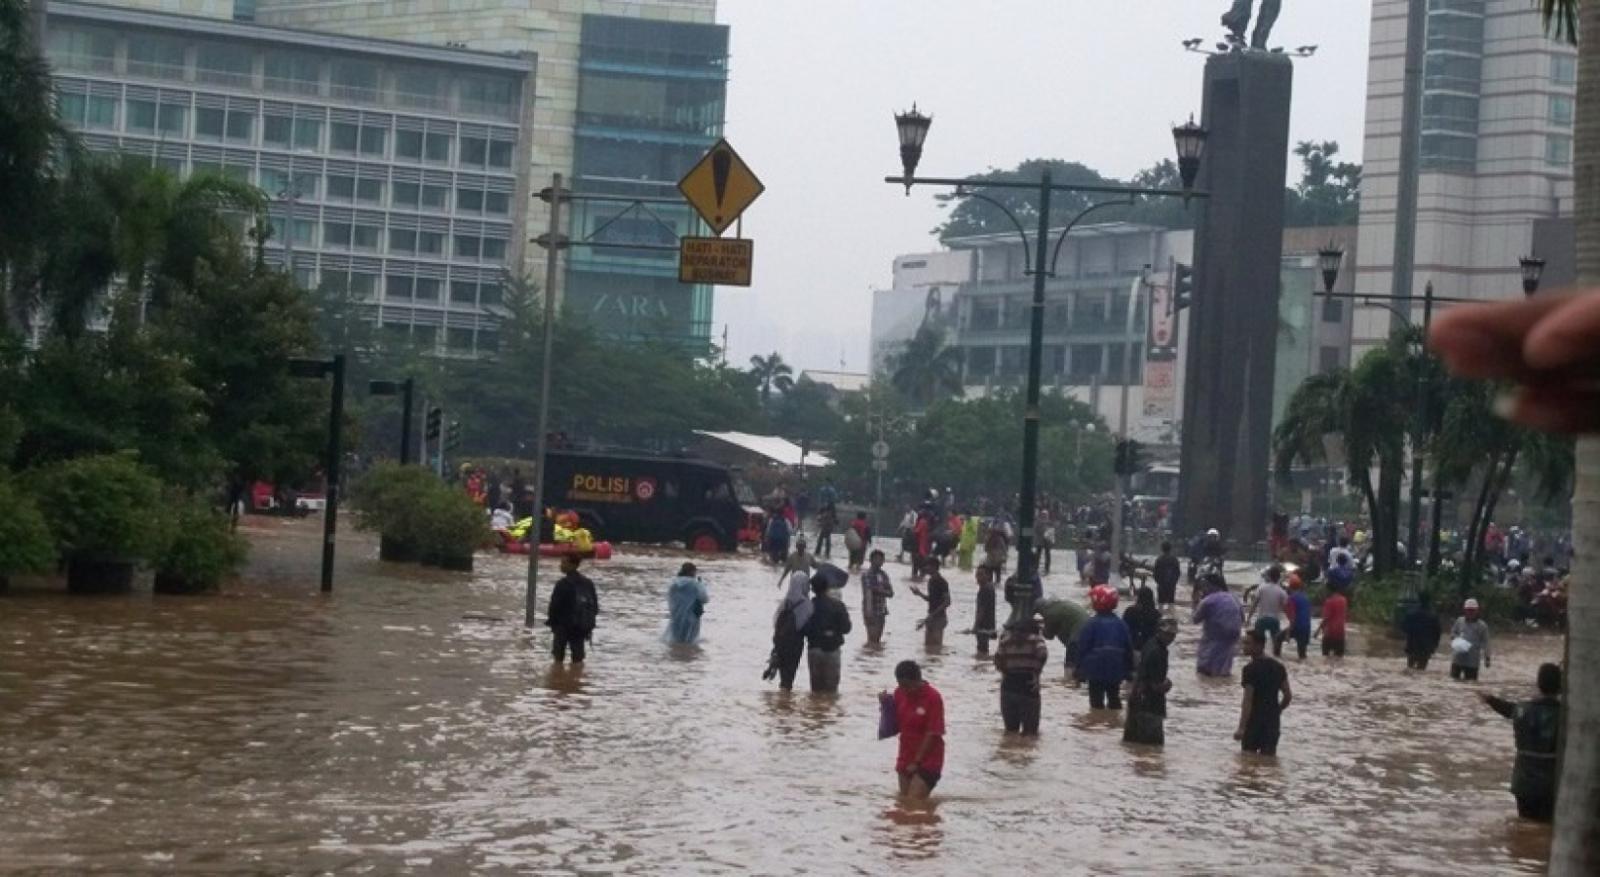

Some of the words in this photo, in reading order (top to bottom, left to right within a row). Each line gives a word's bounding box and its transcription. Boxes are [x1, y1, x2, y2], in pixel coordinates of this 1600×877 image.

[684, 254, 747, 267] SEPARATOR
[592, 292, 669, 317] ZARA
[574, 474, 629, 493] POLISI
